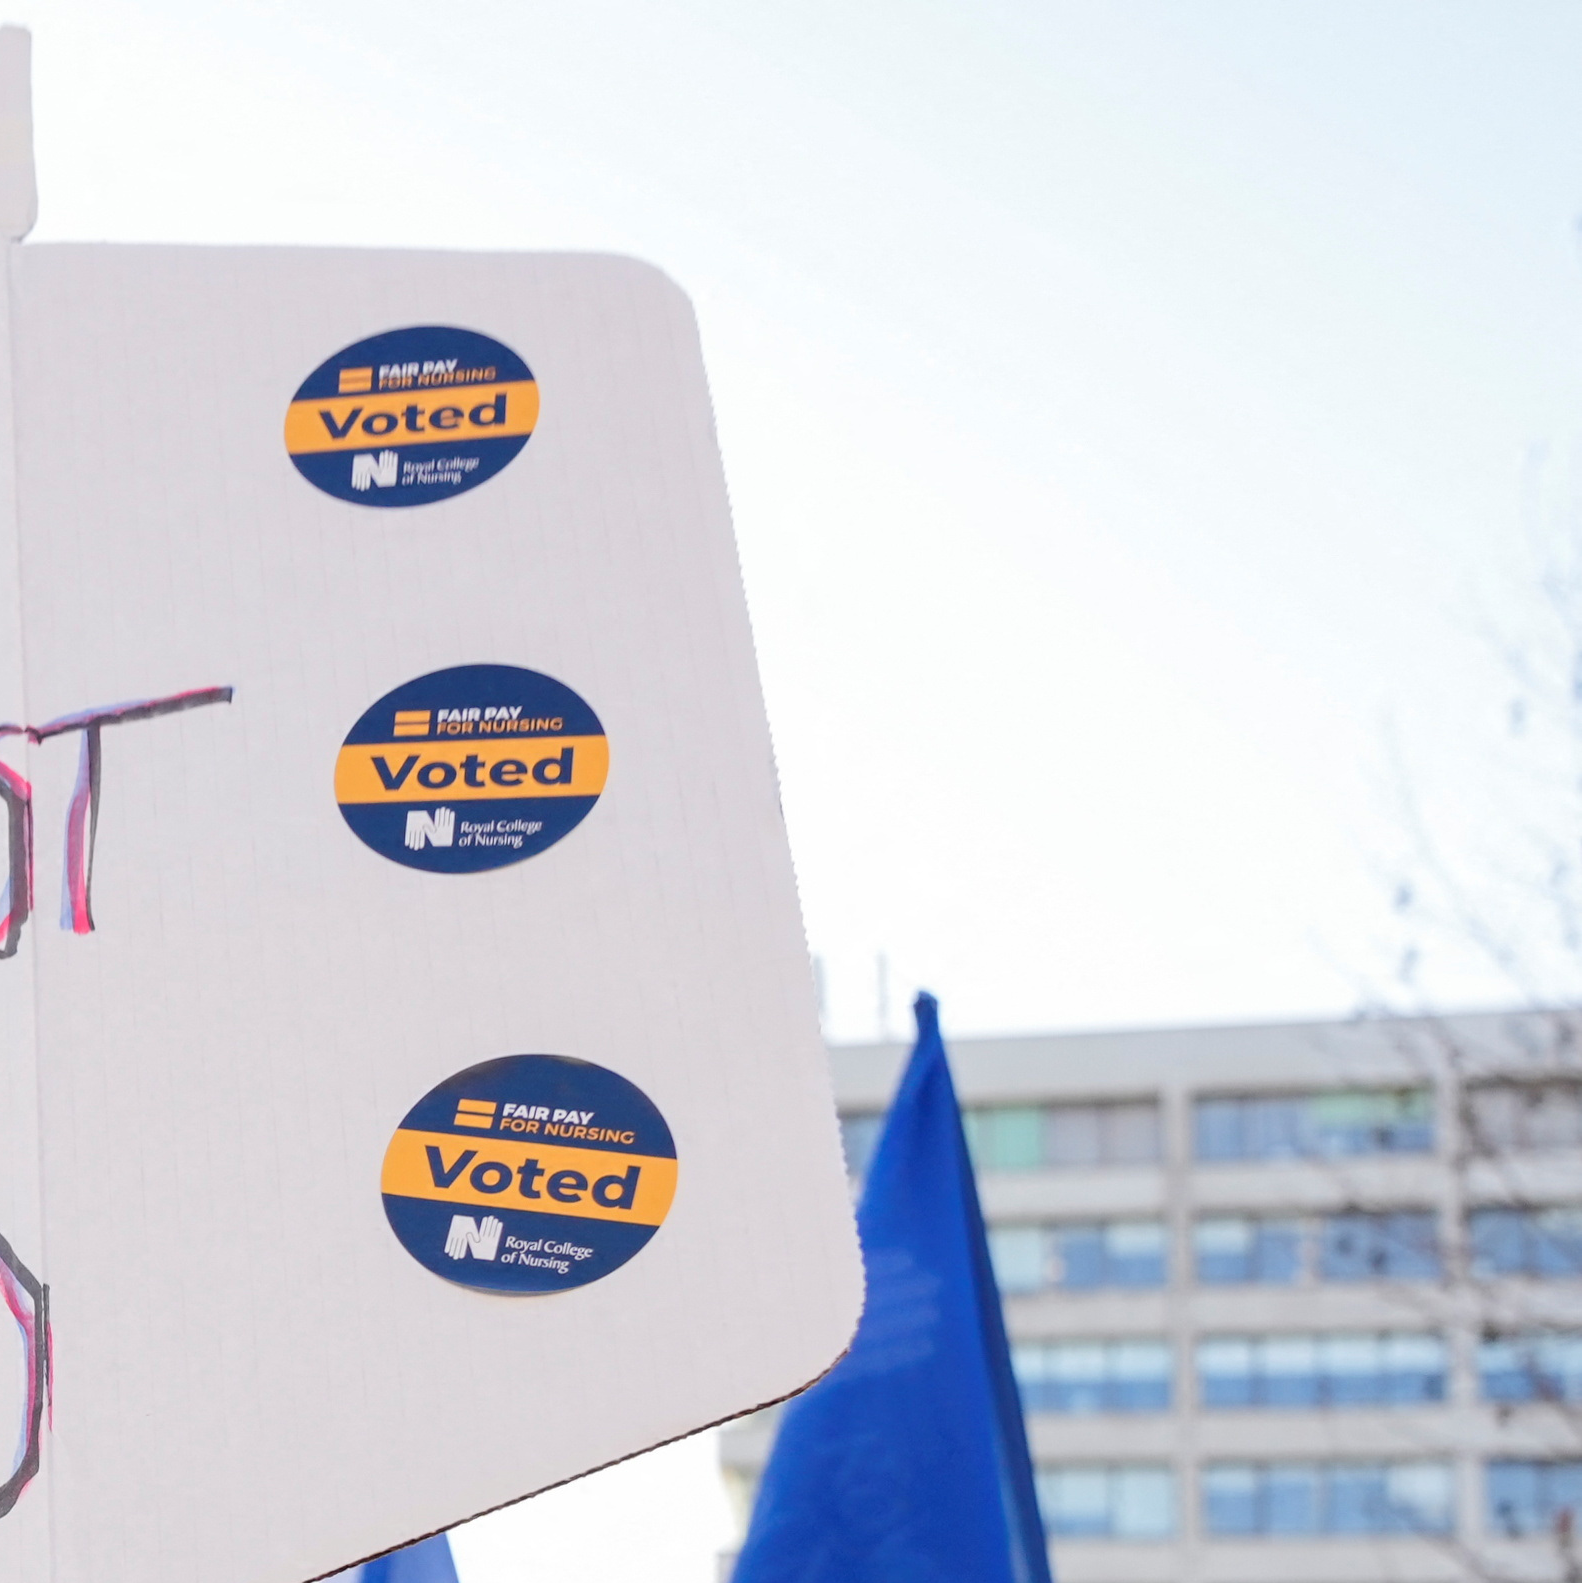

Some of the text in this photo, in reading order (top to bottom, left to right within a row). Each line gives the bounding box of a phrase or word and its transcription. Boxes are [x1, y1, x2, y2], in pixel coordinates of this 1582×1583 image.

[319, 391, 508, 441] Voted
[437, 705, 523, 724] FAIR PAY
[436, 720, 474, 735] FOR
[371, 746, 575, 792] Voted
[460, 819, 543, 836] Royal College
[474, 833, 524, 849] Nursing
[502, 1103, 595, 1126] FAIR PAY
[499, 1118, 636, 1145] FOR NURSING
[424, 1144, 642, 1211] Voted
[505, 1235, 594, 1261] Royal College
[501, 1251, 570, 1275] of Nursing
